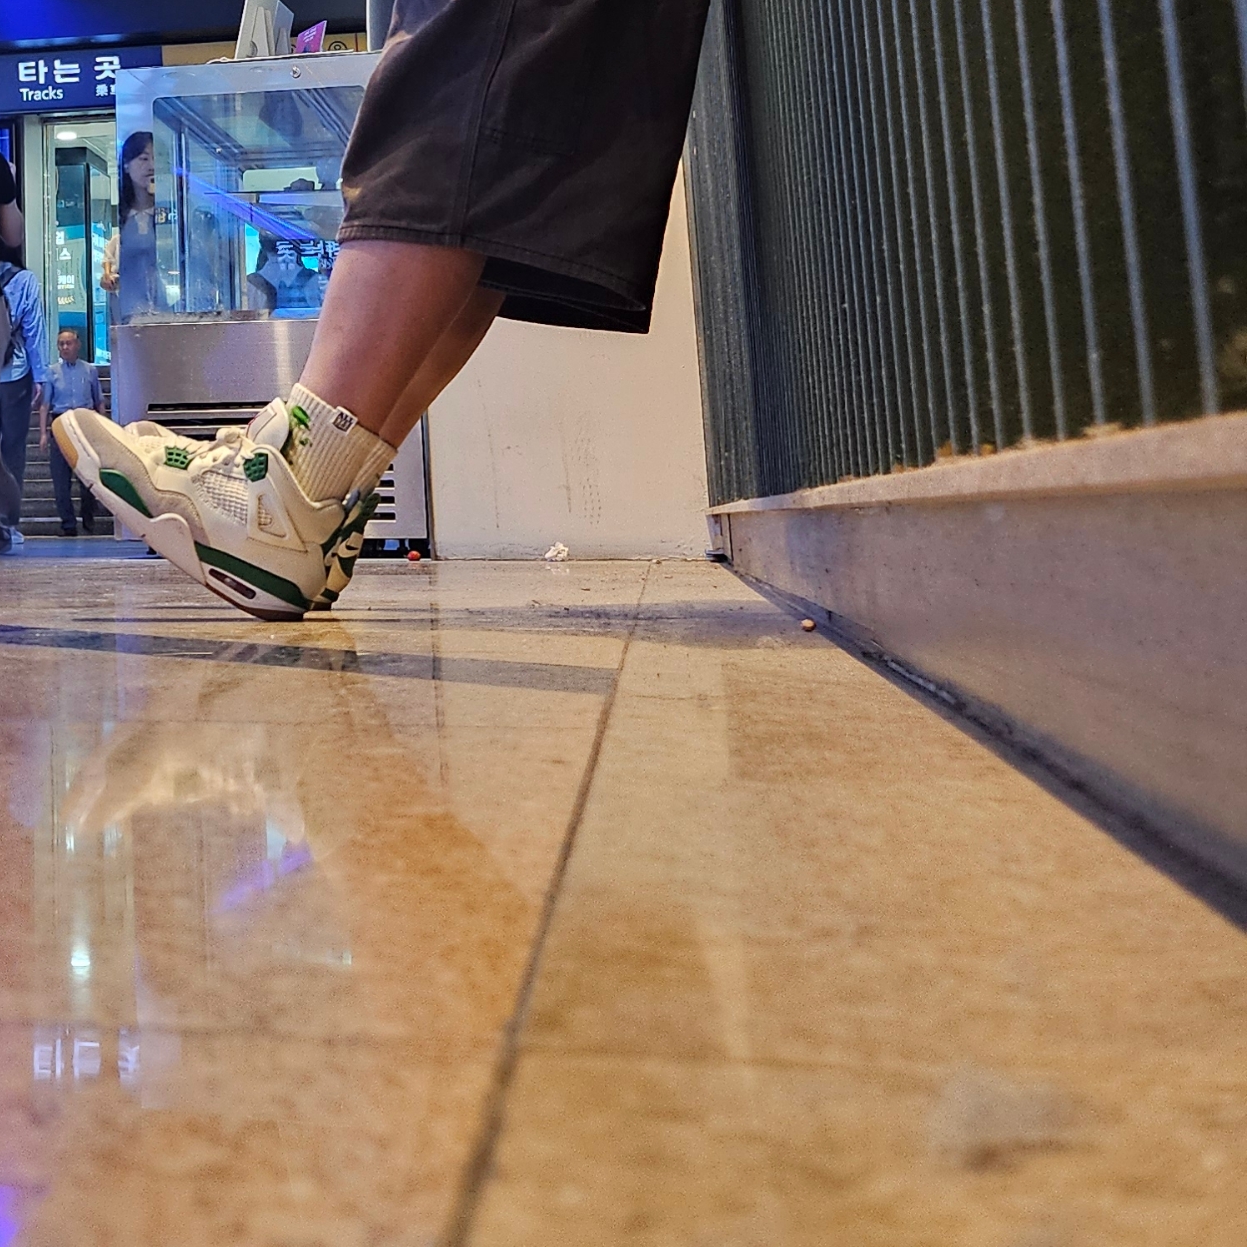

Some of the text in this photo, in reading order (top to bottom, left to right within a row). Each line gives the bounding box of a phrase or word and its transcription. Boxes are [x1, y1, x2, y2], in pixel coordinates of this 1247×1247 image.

[18, 56, 121, 84] 타는 곳
[19, 86, 64, 101] Tracks
